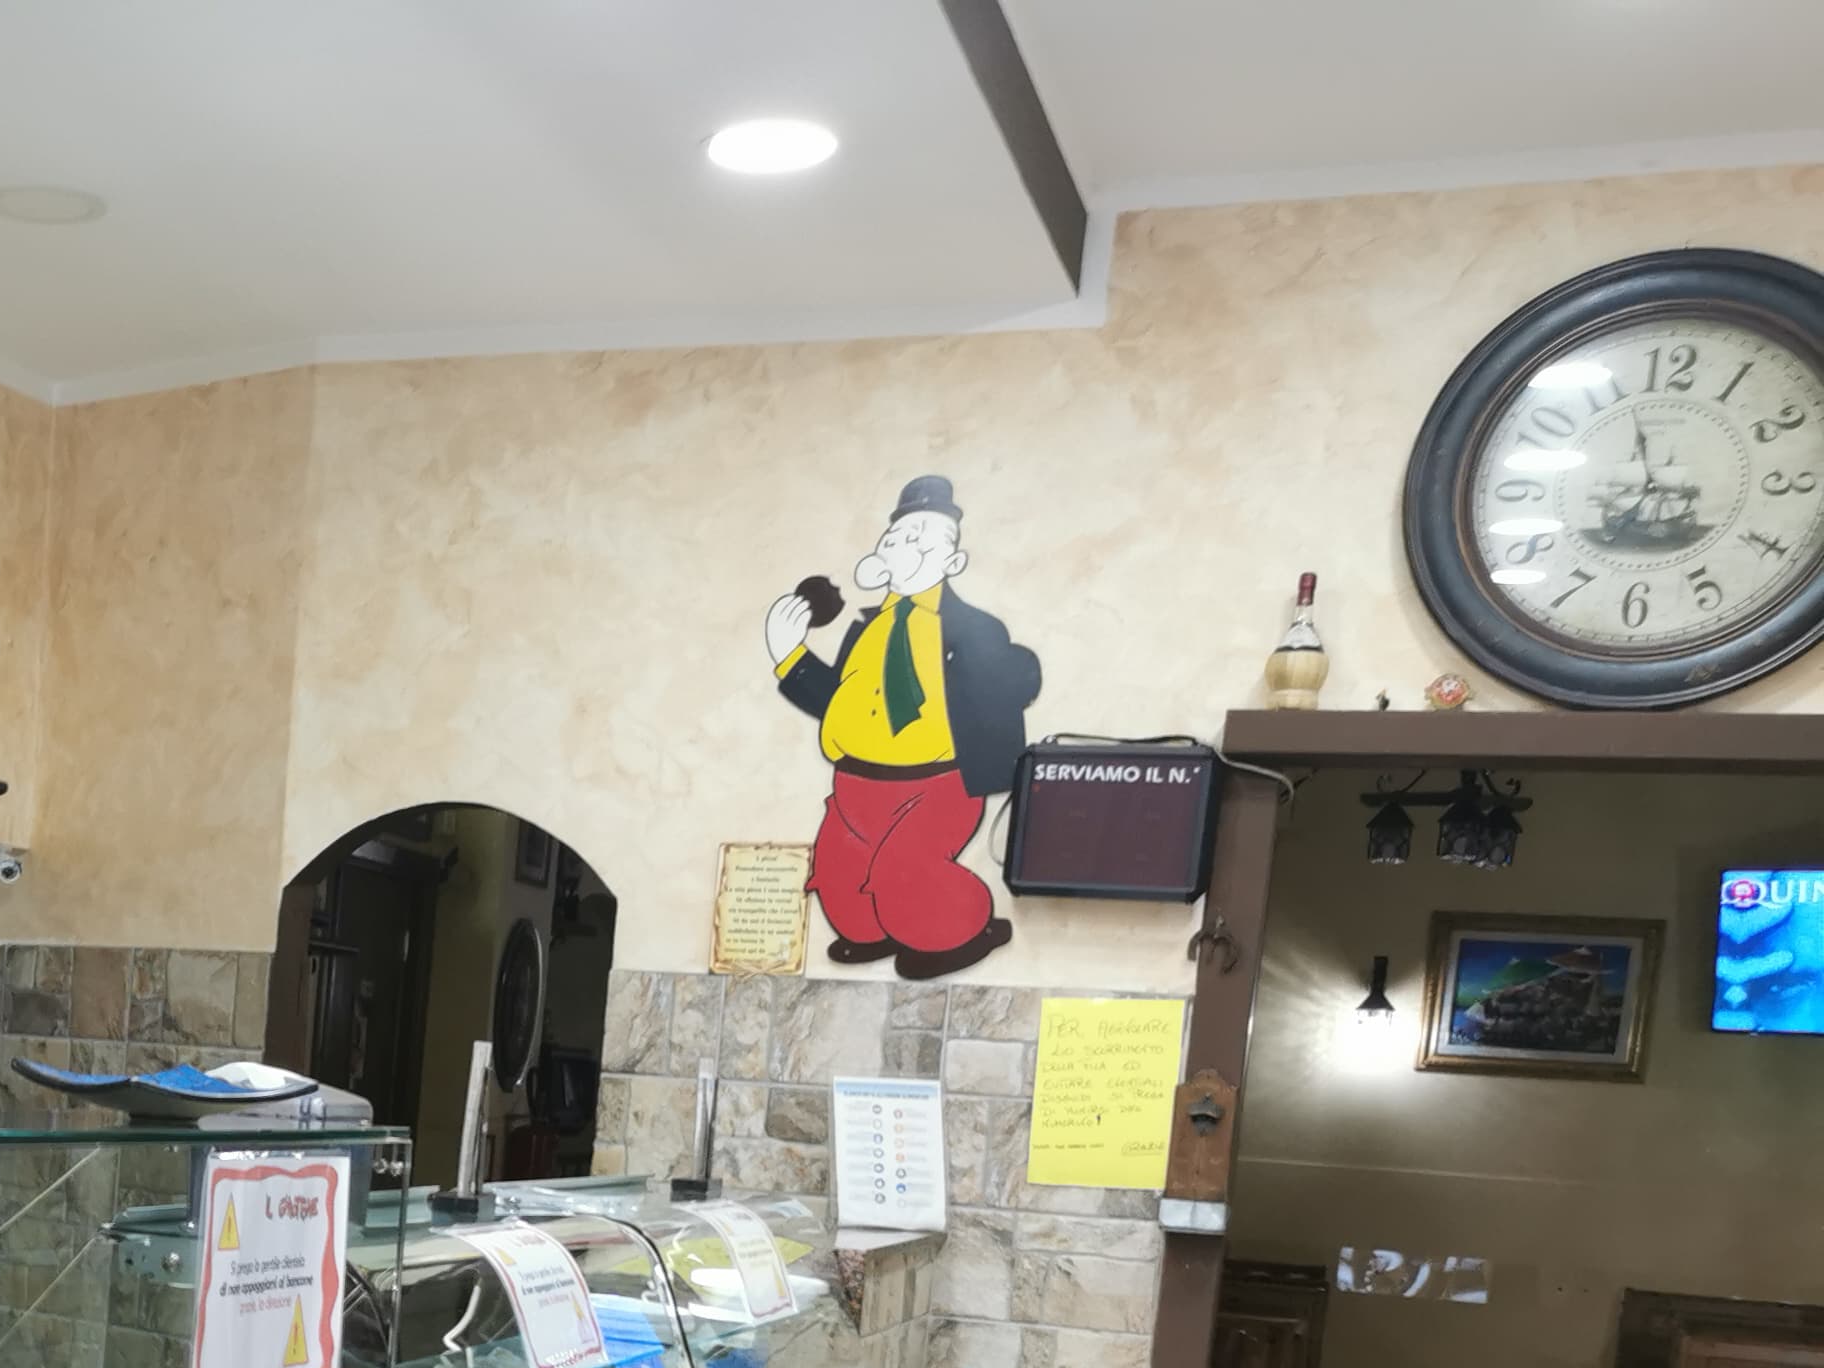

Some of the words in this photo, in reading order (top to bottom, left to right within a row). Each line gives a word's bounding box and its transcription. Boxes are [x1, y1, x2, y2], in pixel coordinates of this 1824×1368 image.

[1641, 344, 1697, 393] 12
[1716, 362, 1755, 402] 1
[1749, 405, 1805, 442] 2
[1761, 471, 1816, 496] 3
[1550, 568, 1598, 608] 7
[1622, 581, 1651, 629] 6
[1688, 566, 1723, 611] 5
[1034, 763, 1141, 783] SERVIAMO
[1145, 766, 1164, 783] IL
